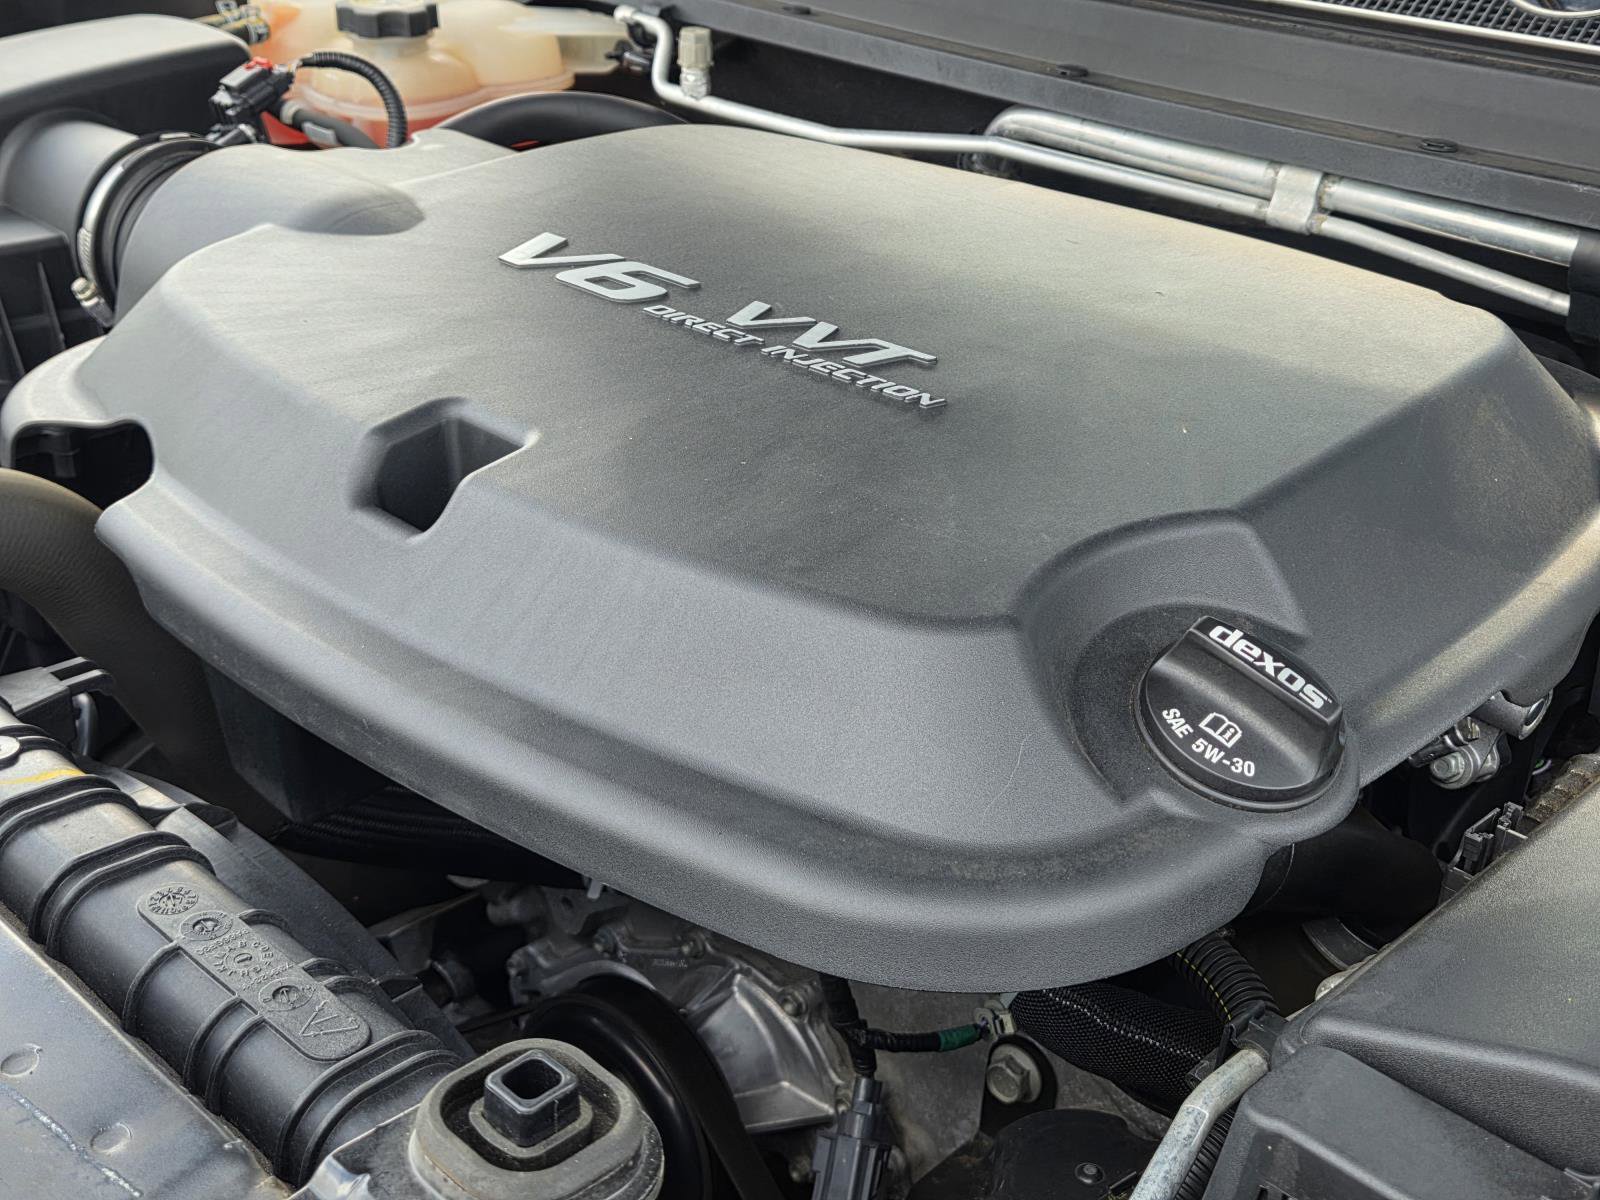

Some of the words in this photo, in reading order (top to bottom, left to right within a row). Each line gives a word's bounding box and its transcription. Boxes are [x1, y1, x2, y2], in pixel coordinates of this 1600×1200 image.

[498, 231, 701, 303] V6
[725, 300, 938, 368] VVT
[643, 303, 765, 346] DIRECT
[761, 345, 948, 409] INJECTION
[1208, 625, 1328, 710] dexos
[1162, 707, 1194, 739] SAE
[1191, 737, 1256, 777] 5W-30
